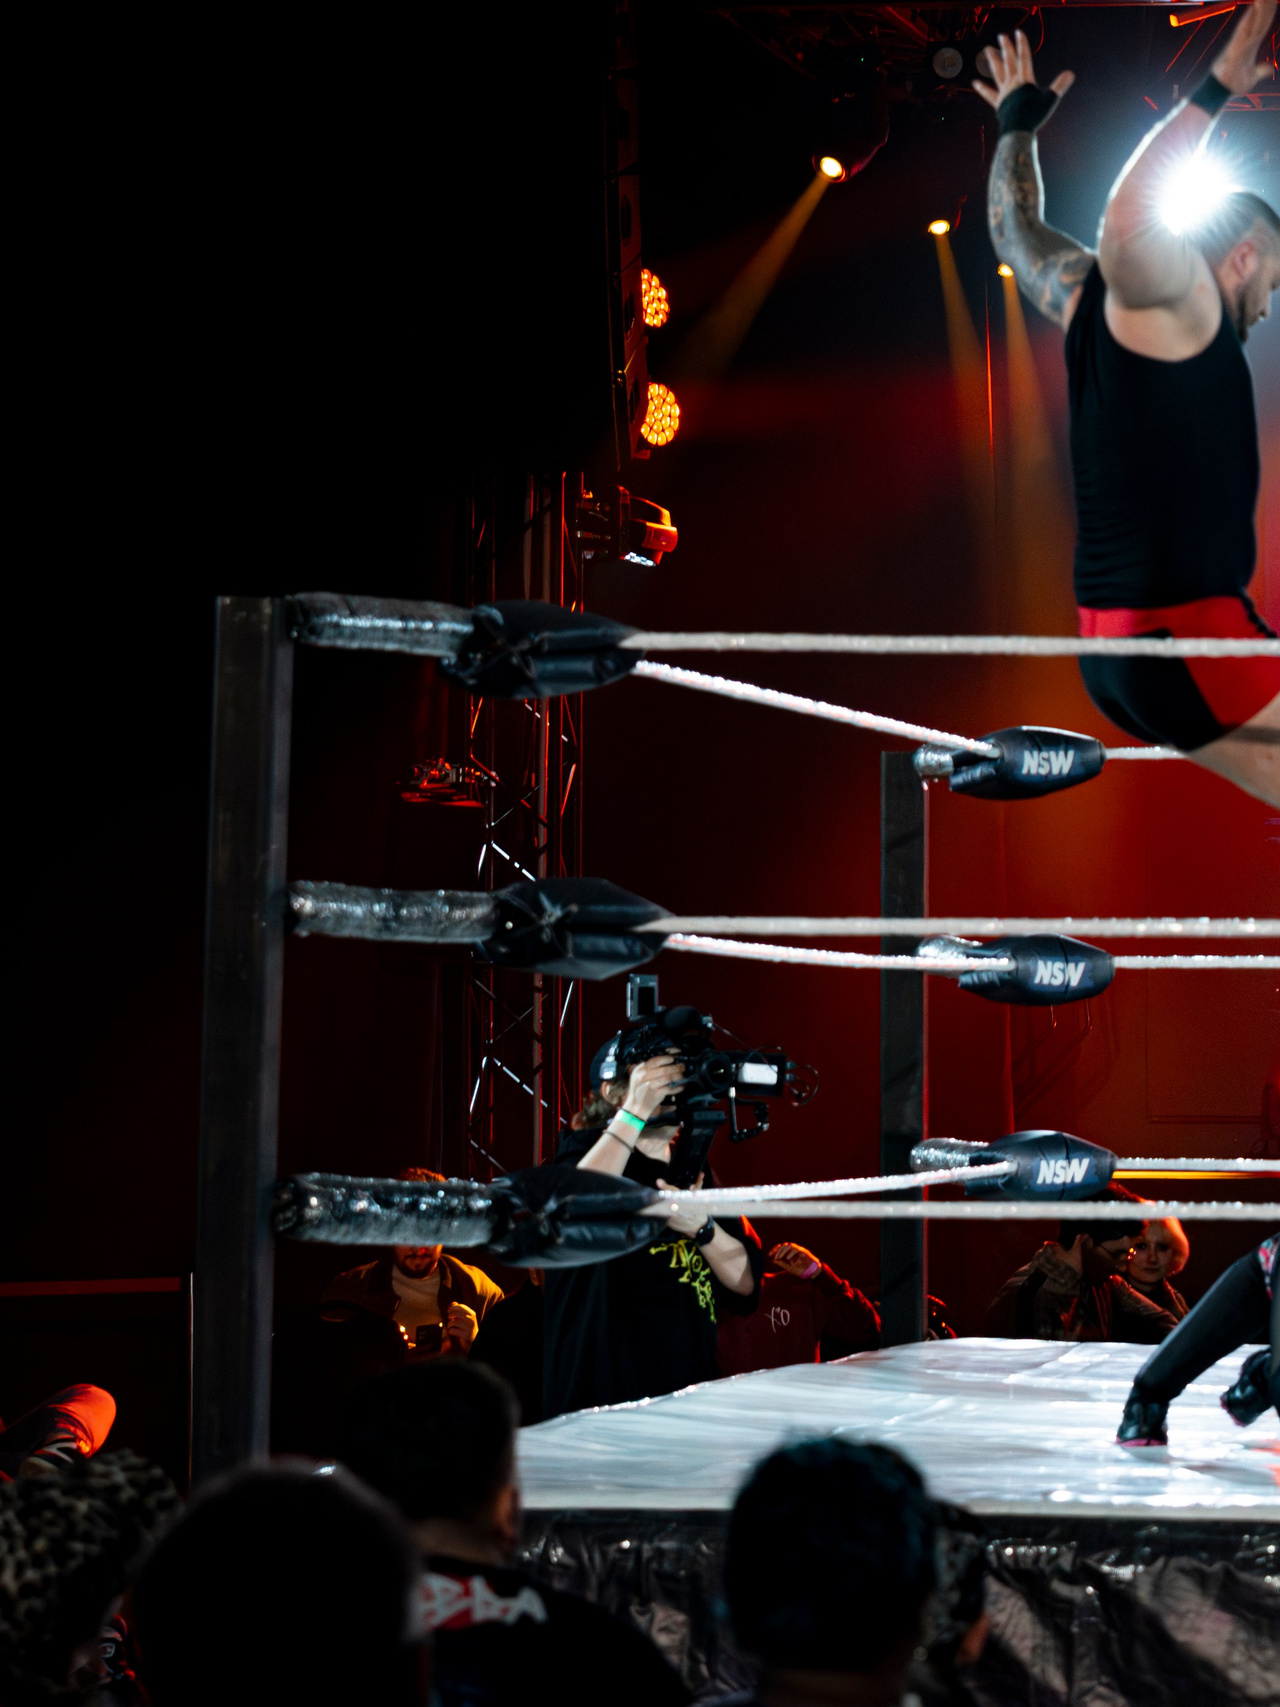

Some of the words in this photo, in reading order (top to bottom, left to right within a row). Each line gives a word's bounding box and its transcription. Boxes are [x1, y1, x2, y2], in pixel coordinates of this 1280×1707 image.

[1021, 750, 1074, 775] NSW
[1034, 960, 1086, 987] NSW
[1036, 1158, 1090, 1184] NSW
